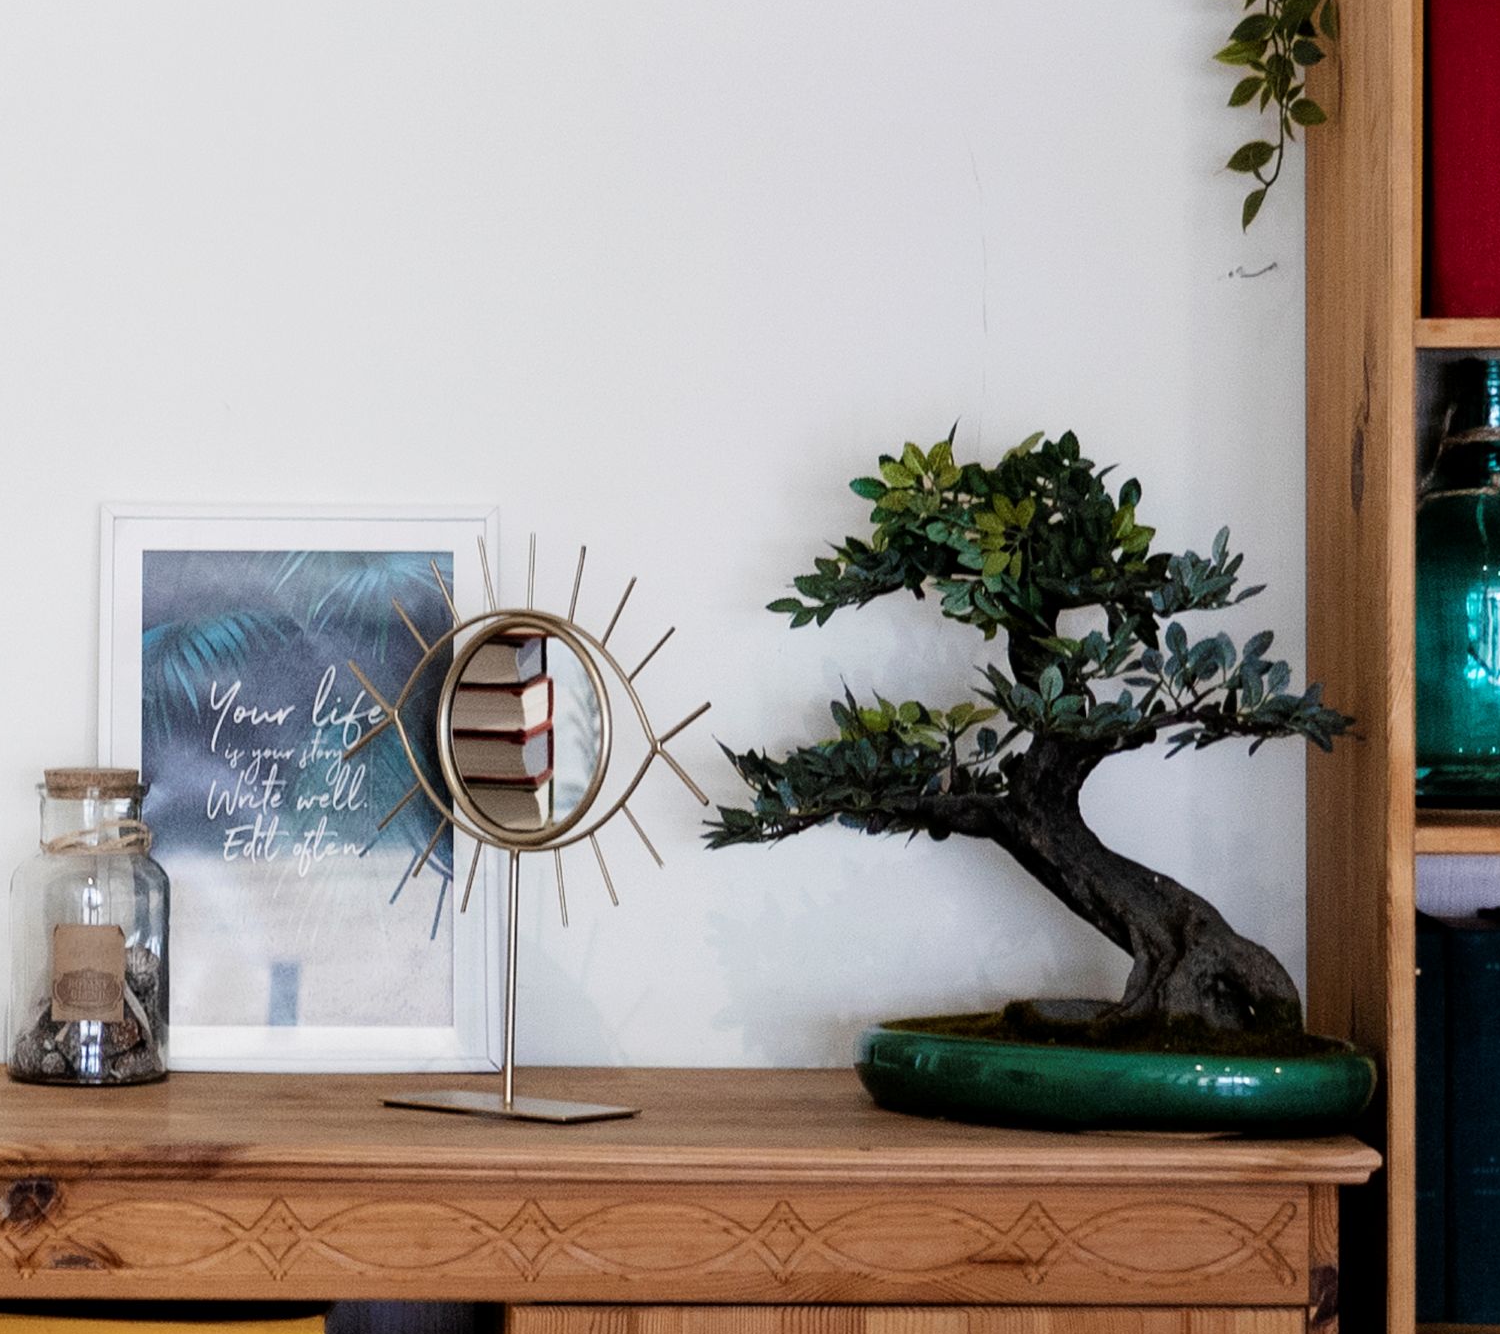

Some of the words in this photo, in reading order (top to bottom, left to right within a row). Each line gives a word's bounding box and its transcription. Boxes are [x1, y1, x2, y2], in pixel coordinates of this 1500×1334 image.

[210, 680, 295, 752] Your
[312, 665, 385, 749] life
[207, 763, 287, 820] Write
[296, 763, 368, 811] well.
[224, 742, 245, 768] is
[244, 747, 295, 785] your
[223, 814, 289, 863] Edit
[292, 816, 371, 877] often.
